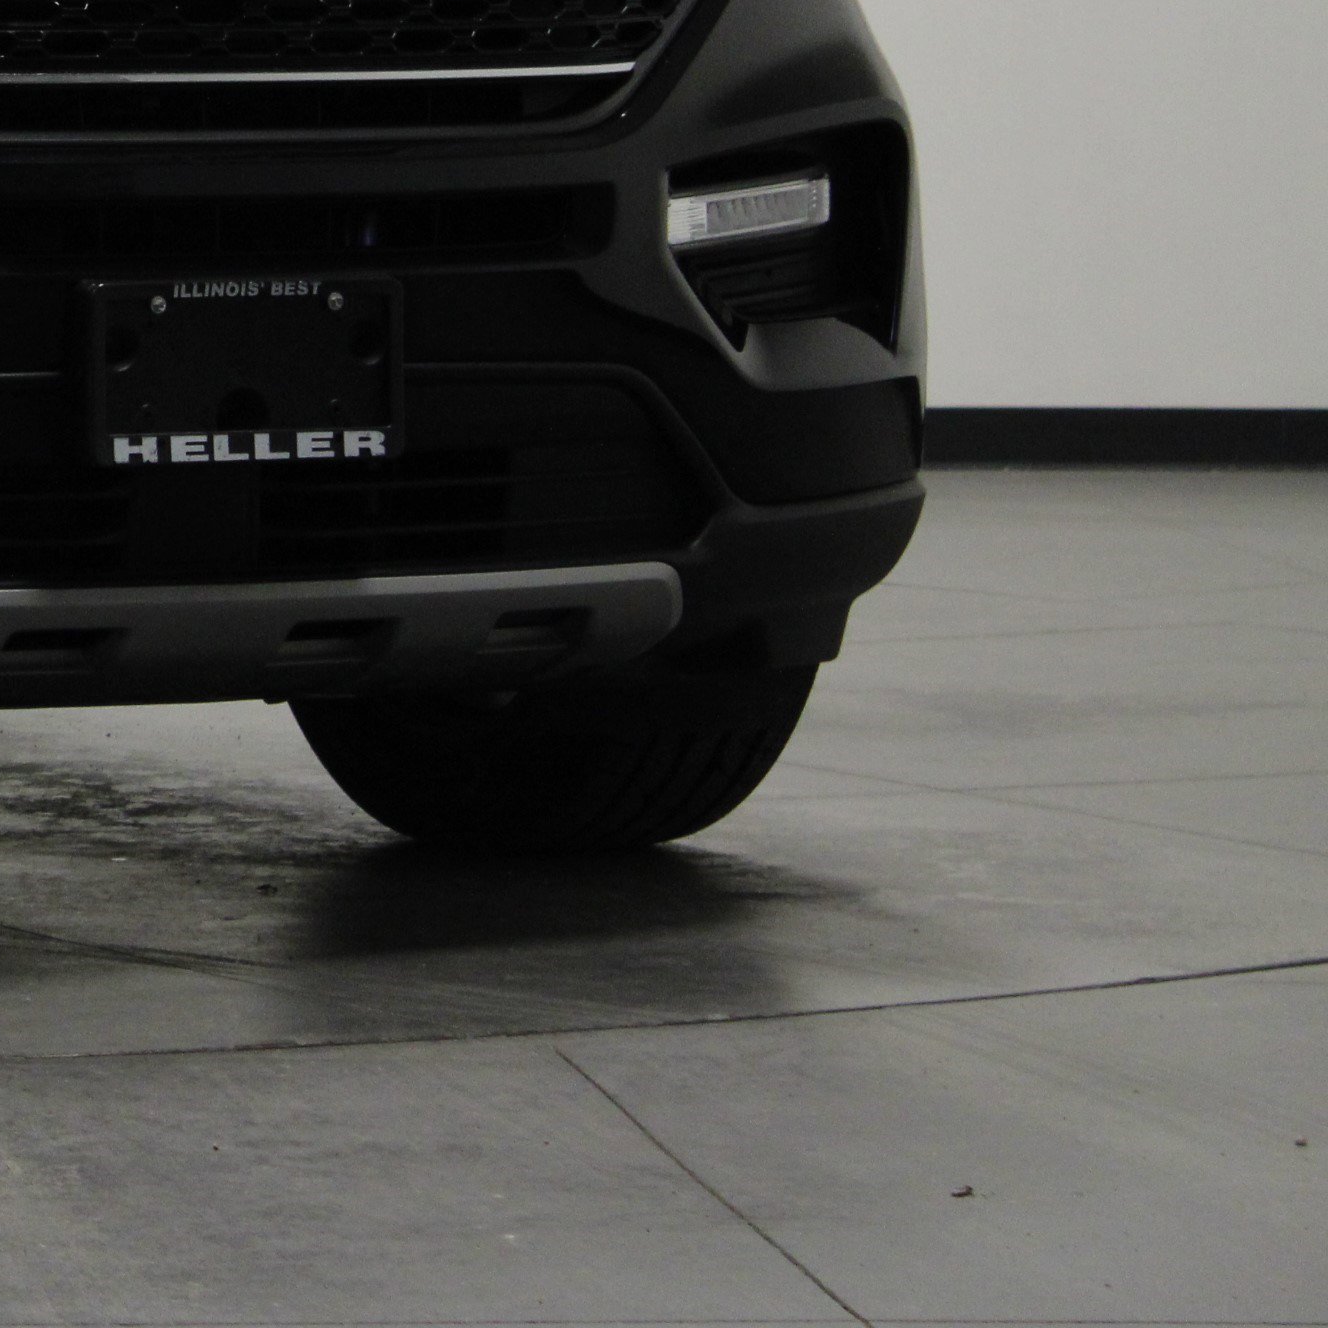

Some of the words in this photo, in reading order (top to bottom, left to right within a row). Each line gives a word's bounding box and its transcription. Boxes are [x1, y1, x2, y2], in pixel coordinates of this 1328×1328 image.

[173, 281, 265, 299] ILLINOIS'
[270, 280, 323, 297] BEST
[113, 430, 387, 464] HELLER
